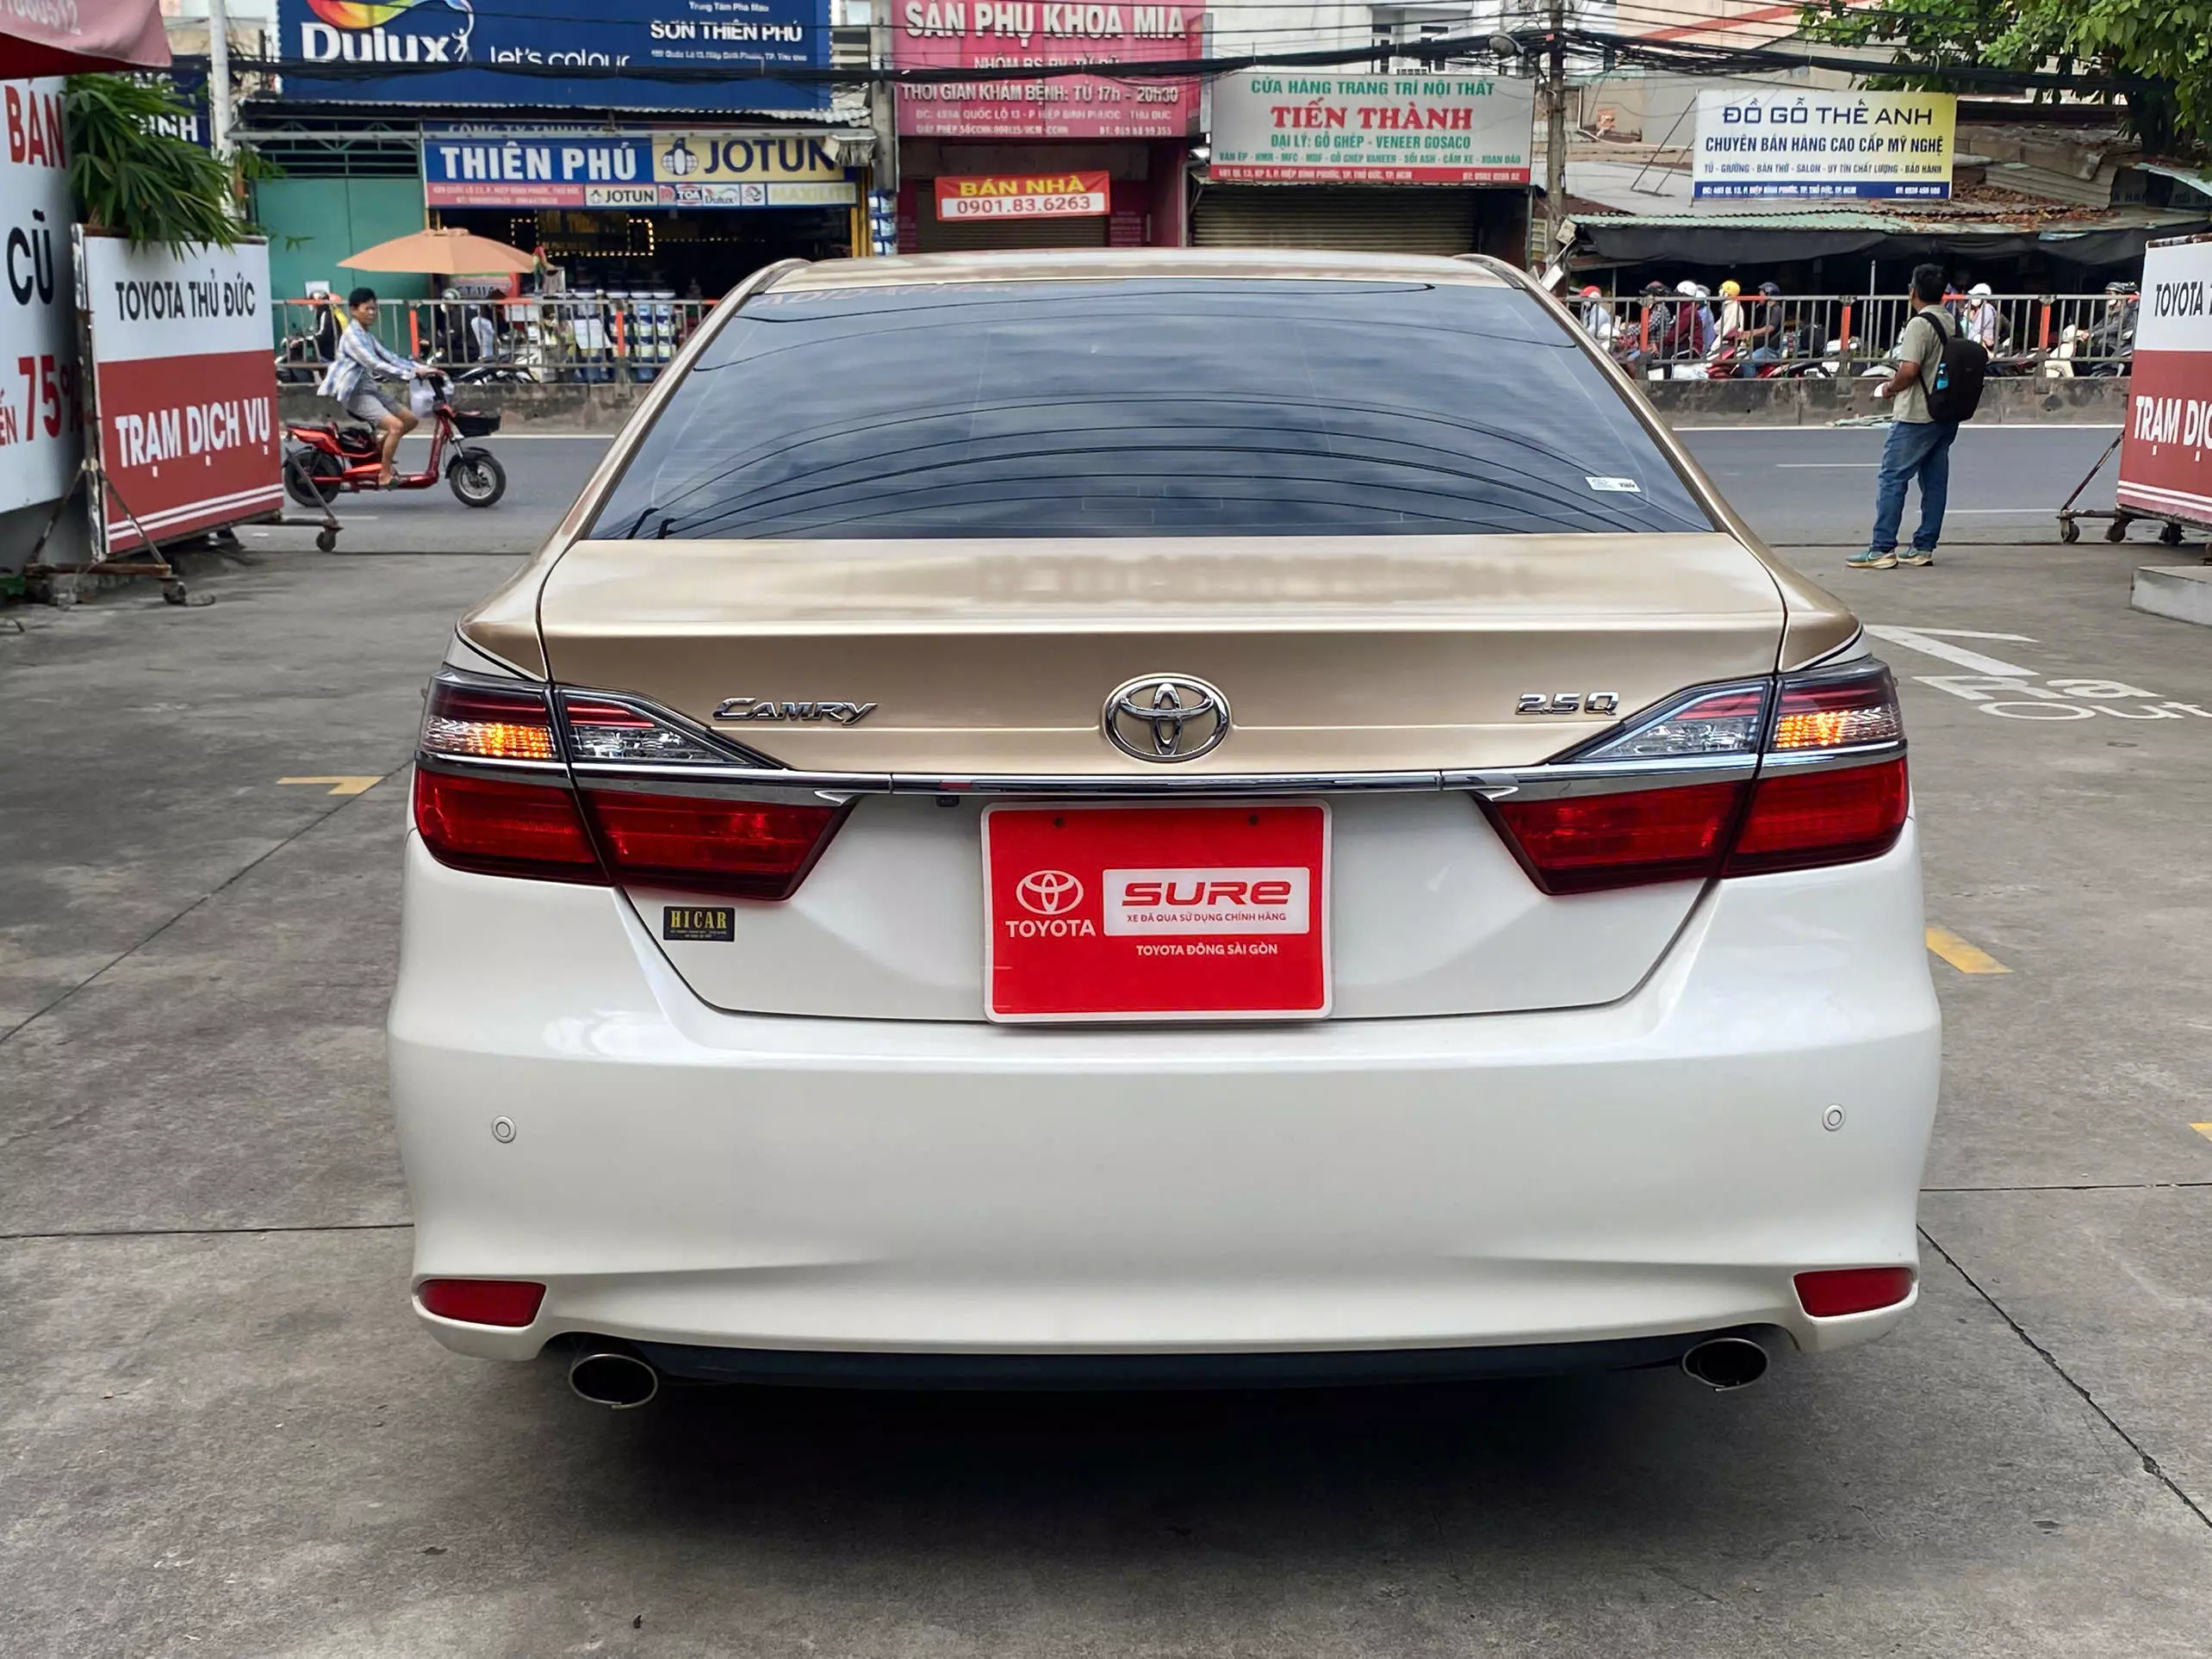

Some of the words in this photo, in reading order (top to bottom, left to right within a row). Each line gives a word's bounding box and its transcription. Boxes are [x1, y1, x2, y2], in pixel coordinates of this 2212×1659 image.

[699, 19, 758, 40] THIÊN
[975, 2, 1035, 47] PHỤ
[1044, 4, 1124, 39] KHOA
[1134, 6, 1186, 40] MIA
[301, 22, 450, 63] Dulux
[490, 46, 543, 65] let's
[940, 84, 976, 101] GIAN
[979, 80, 1022, 101] KHÁM
[1288, 78, 1331, 94] HÀNG
[1337, 81, 1388, 95] TRANG
[1423, 79, 1451, 98] NỘI
[1271, 96, 1348, 128] TIẾN
[1357, 102, 1474, 129] THÀNH
[1723, 97, 1762, 124] ĐỒ
[1770, 97, 1808, 124] GỖ
[1815, 98, 1868, 125] THẾ
[1874, 108, 1933, 126] ANH
[1376, 135, 1420, 149] VENEER
[1425, 135, 1471, 149] GOSACO
[1706, 134, 1756, 152] CHUYÊN
[1792, 134, 1826, 152] HÀNG
[1830, 137, 1855, 152] CAO
[1859, 132, 1884, 152] CẤP
[1911, 135, 1943, 156] NGHỆ
[439, 140, 552, 179] THIÊN
[562, 141, 637, 180] PHÚ
[704, 140, 835, 173] JOTUN
[1797, 164, 1821, 173] SALON
[606, 190, 655, 203] JOTUN
[960, 178, 1017, 197] BÁN
[1026, 176, 1086, 195] NHÀ
[956, 196, 1090, 214] 0901.83.6263
[7, 208, 54, 305] CŨ
[115, 281, 185, 320] TOYOTA
[189, 269, 221, 318] THỦ
[223, 271, 256, 317] ĐỨC
[2155, 281, 2203, 317] TOYOTA
[115, 407, 182, 477] TRẠM
[186, 398, 240, 466] DỊCH
[244, 396, 270, 455] VỤ
[2134, 395, 2182, 456] TRẠM
[712, 697, 878, 725] CAMRY
[1004, 919, 1097, 938] TOYOTA
[1127, 914, 1138, 923] XE
[1156, 913, 1177, 923] QUA
[1225, 910, 1256, 922] CHÍNH
[1136, 944, 1185, 956] TOYOTA
[1186, 941, 1224, 956] ĐÔNG
[1227, 941, 1246, 955] SÀI
[1248, 941, 1278, 955] GÒN
